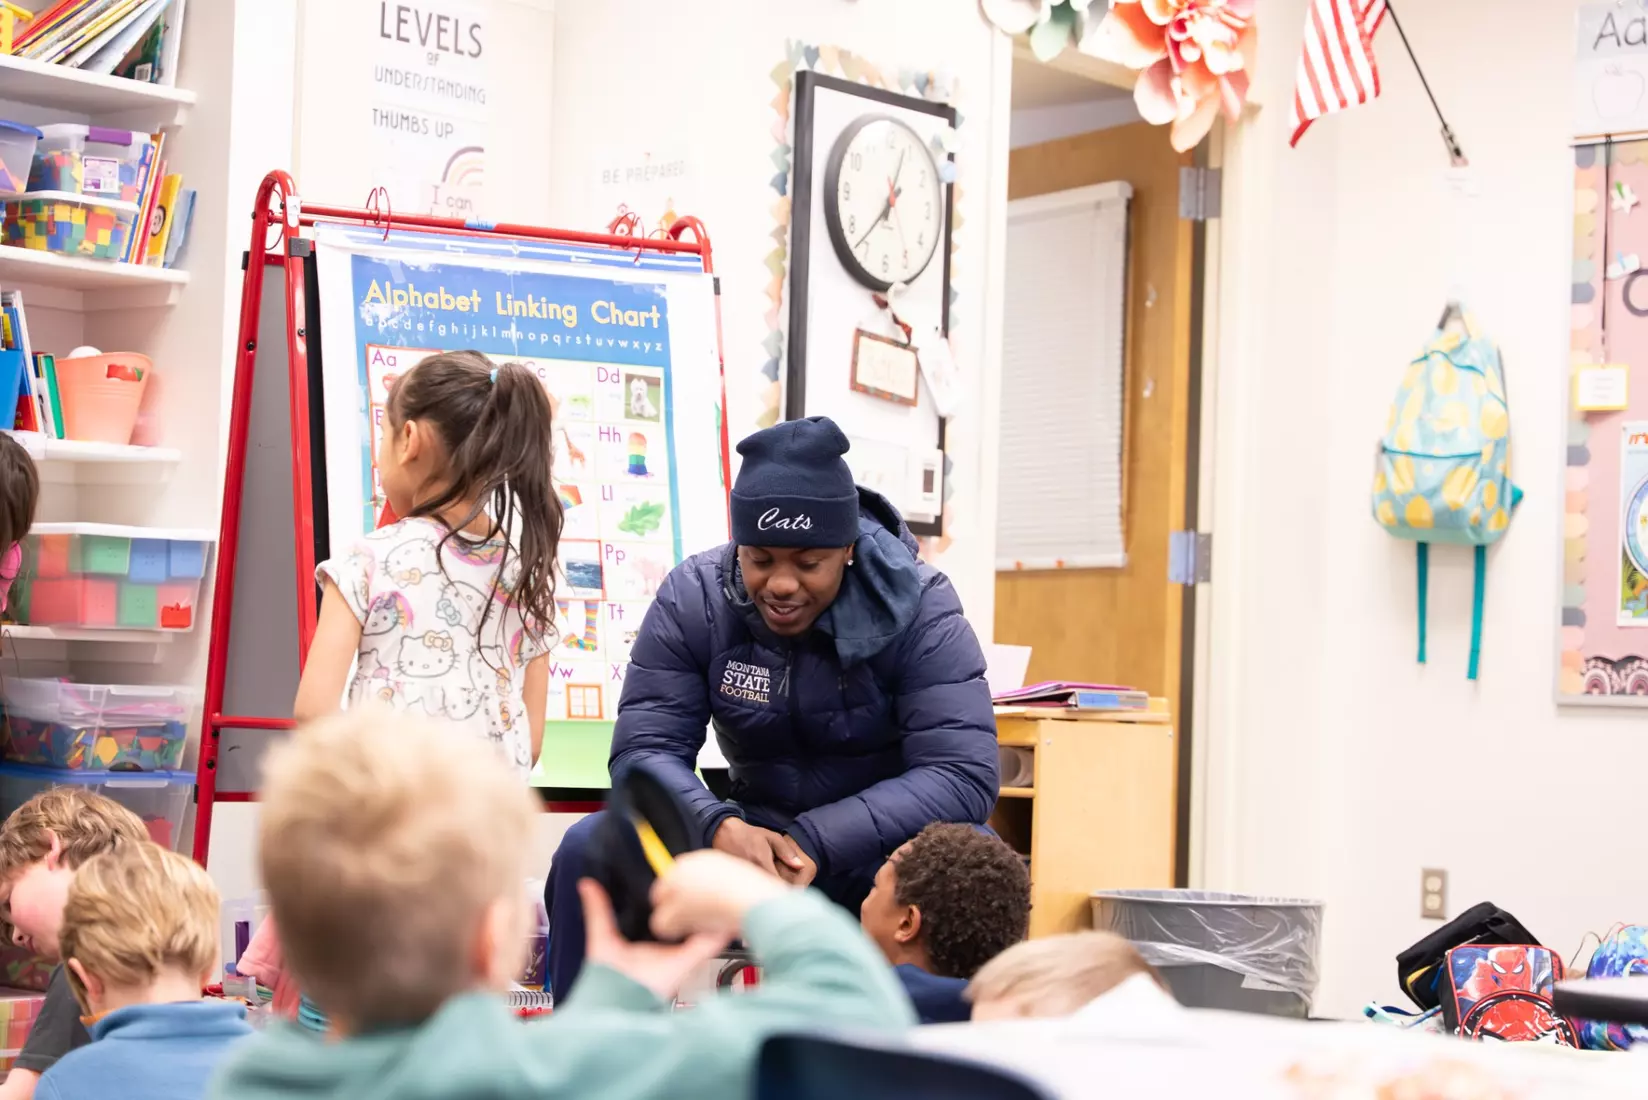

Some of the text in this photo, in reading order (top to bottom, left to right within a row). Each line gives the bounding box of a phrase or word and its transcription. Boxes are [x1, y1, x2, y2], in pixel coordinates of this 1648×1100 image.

[380, 1, 482, 58] LEVELS
[1593, 11, 1648, 50] Aa
[374, 65, 486, 105] UNDERSTANDING
[372, 108, 454, 140] THUMBS UP
[850, 152, 862, 172] 10
[602, 168, 621, 184] BE
[432, 185, 473, 213] I can
[365, 279, 661, 328] Alphabet Linking Chart
[372, 350, 397, 367] Aa
[597, 366, 620, 384] Dd
[599, 426, 621, 443] Hh
[758, 507, 813, 530] Cats
[605, 543, 626, 566] Pp
[608, 603, 625, 620] Tt
[726, 660, 770, 677] MONTANA
[722, 670, 770, 692] STATE
[720, 684, 770, 703] FOOTBALL
